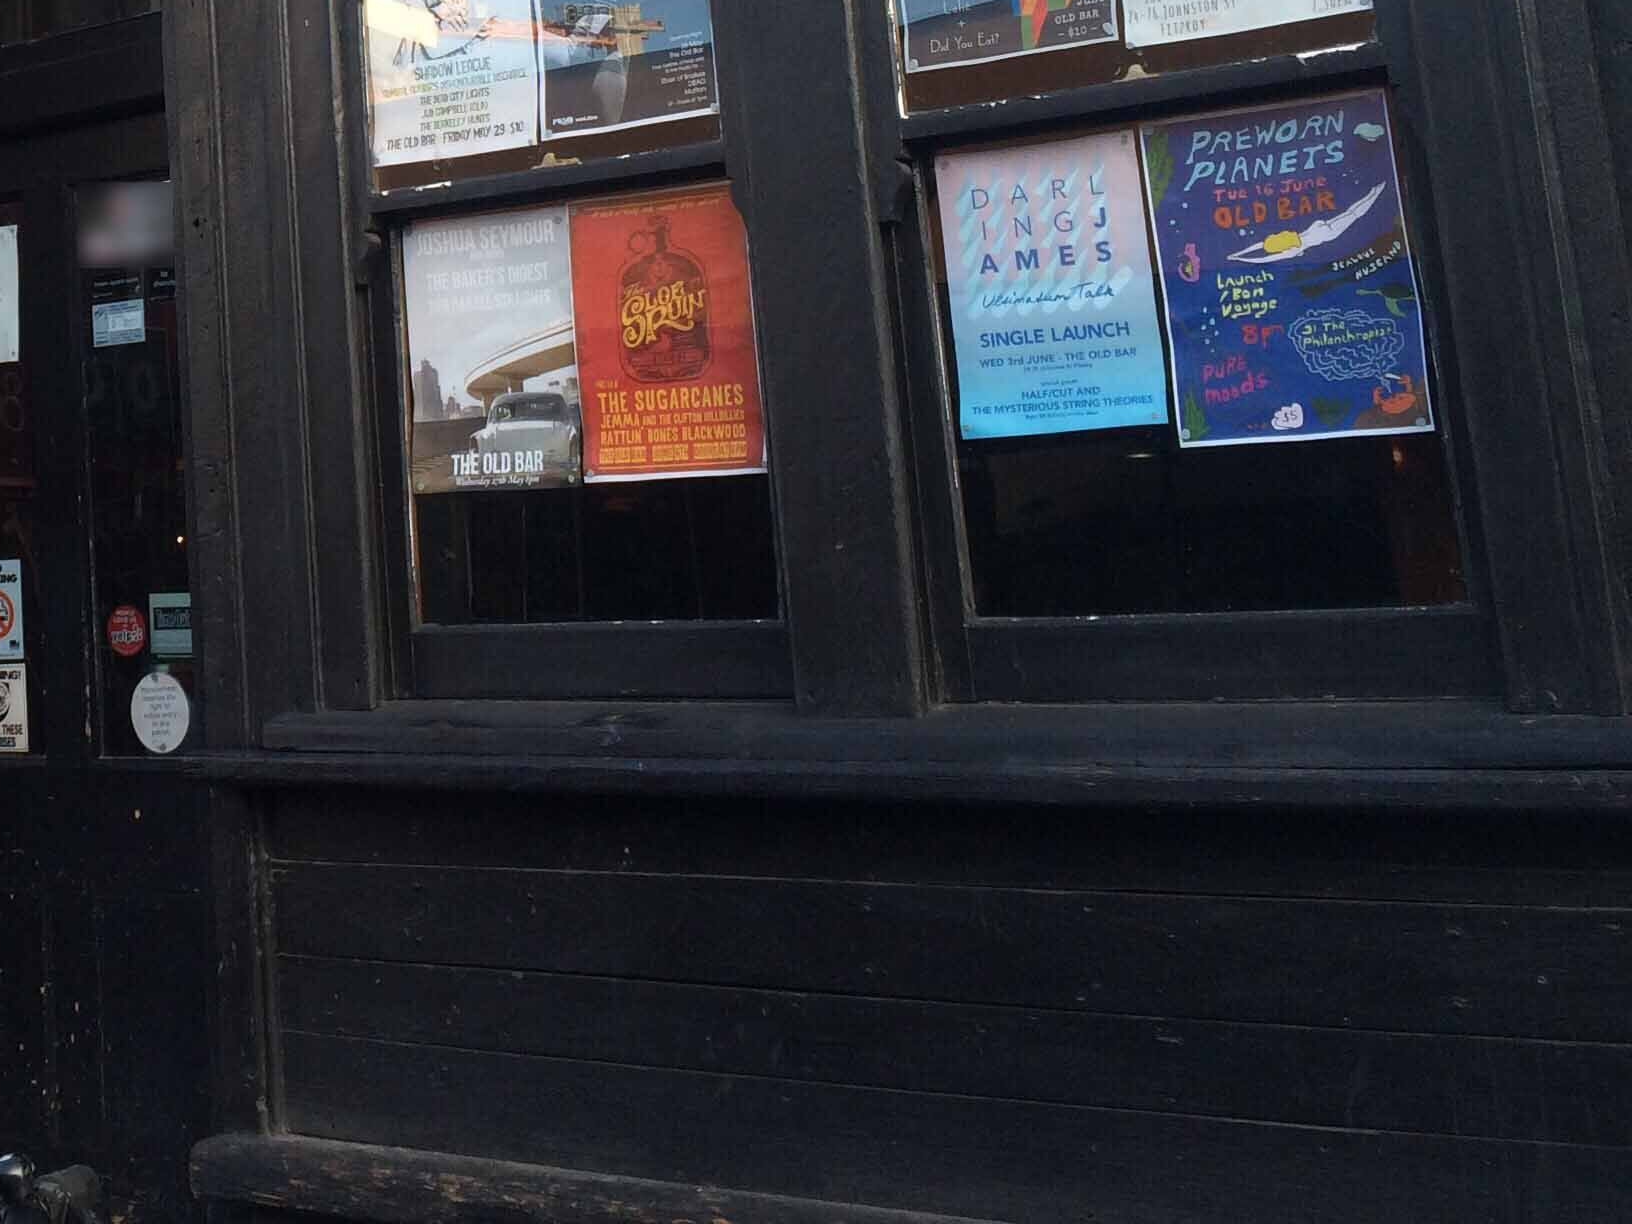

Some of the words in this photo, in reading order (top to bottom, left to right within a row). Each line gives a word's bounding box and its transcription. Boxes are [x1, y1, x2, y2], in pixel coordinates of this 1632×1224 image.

[1054, 12, 1076, 25] OLD
[1079, 9, 1100, 20] BAR
[955, 35, 974, 50] You
[493, 123, 505, 137] 29
[1186, 109, 1345, 165] PREWORN
[1183, 139, 1345, 192] PLANETS
[1213, 202, 1268, 229] OLD
[1276, 191, 1337, 220] BAR
[479, 218, 556, 250] SEYMOUR
[980, 328, 1045, 349] SINGLE
[1051, 321, 1131, 343] LAUNCH
[979, 357, 1004, 369] WED
[1026, 355, 1056, 366] JUNE
[1088, 349, 1112, 360] OLD
[597, 391, 629, 414] THE
[634, 383, 744, 412] SUGARCANES
[451, 452, 480, 476] THE
[482, 451, 511, 475] OLD
[514, 450, 544, 473] BAR
